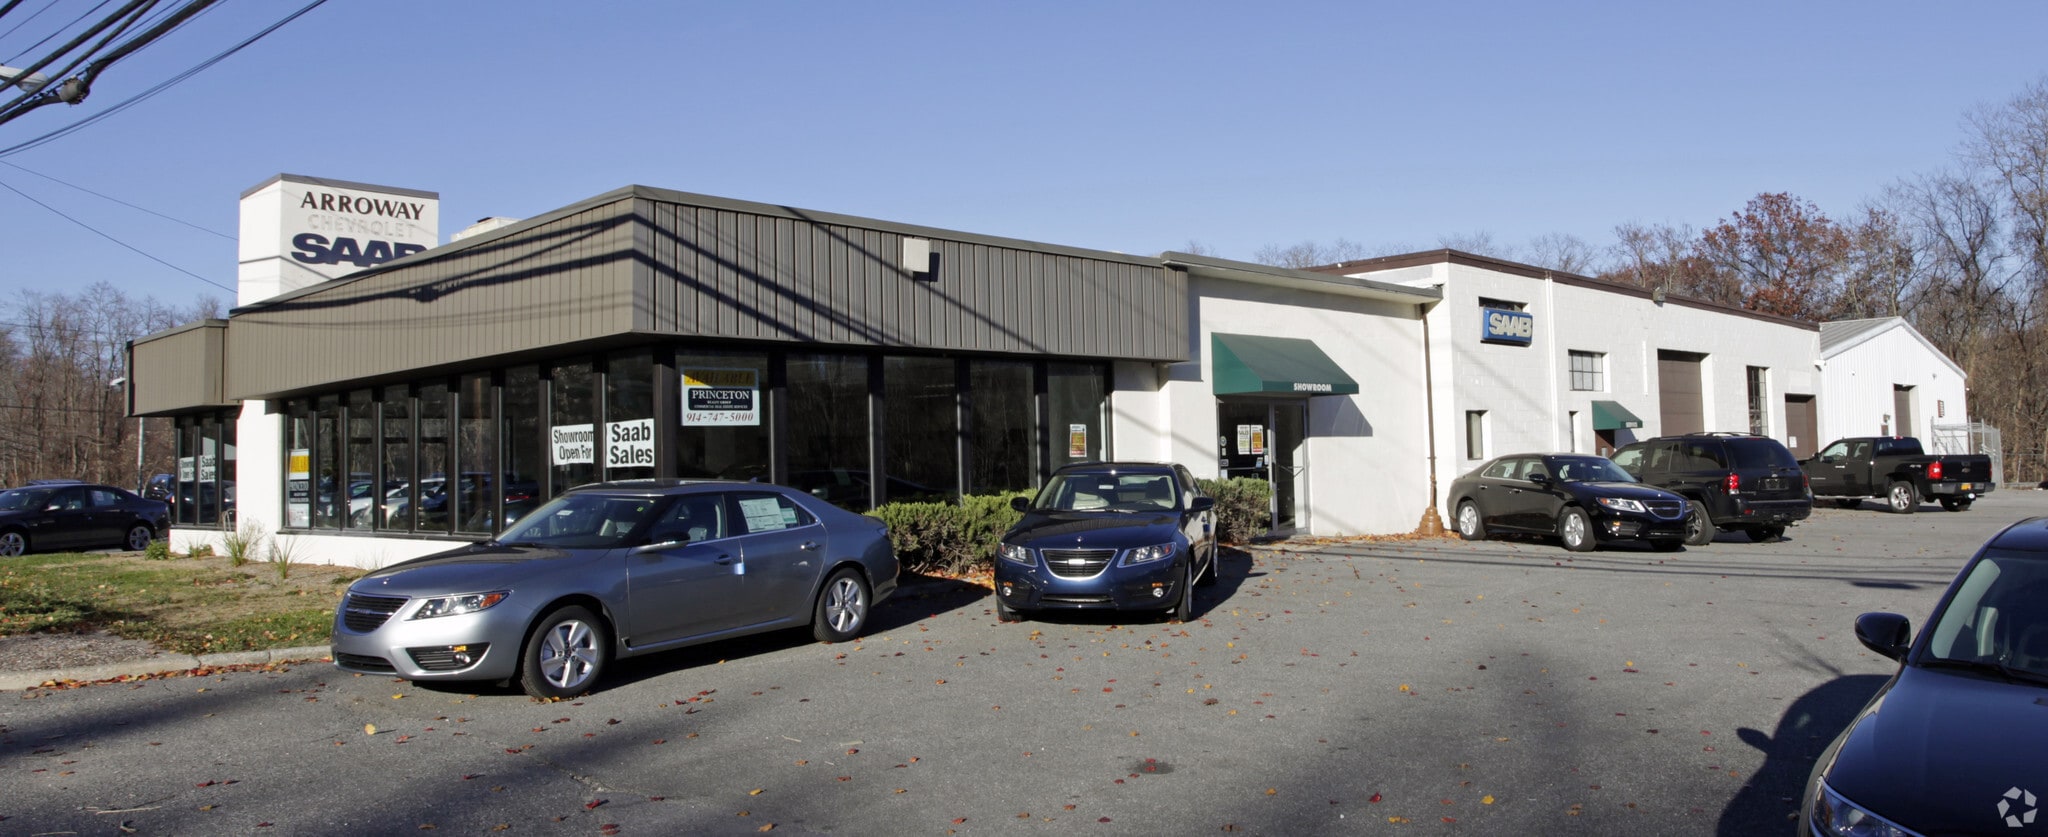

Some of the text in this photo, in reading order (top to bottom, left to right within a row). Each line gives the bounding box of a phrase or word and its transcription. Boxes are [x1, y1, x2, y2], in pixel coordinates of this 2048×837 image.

[300, 191, 425, 220] ARROWAY
[308, 213, 415, 238] CHEVROLET
[1489, 313, 1531, 337] SAAB
[692, 390, 750, 400] PRINCETON
[1293, 382, 1332, 392] SHOWROOM
[686, 412, 753, 422] 914-747-5000
[612, 422, 651, 442] Saab
[559, 445, 592, 461] Open For
[610, 444, 653, 464] Sales
